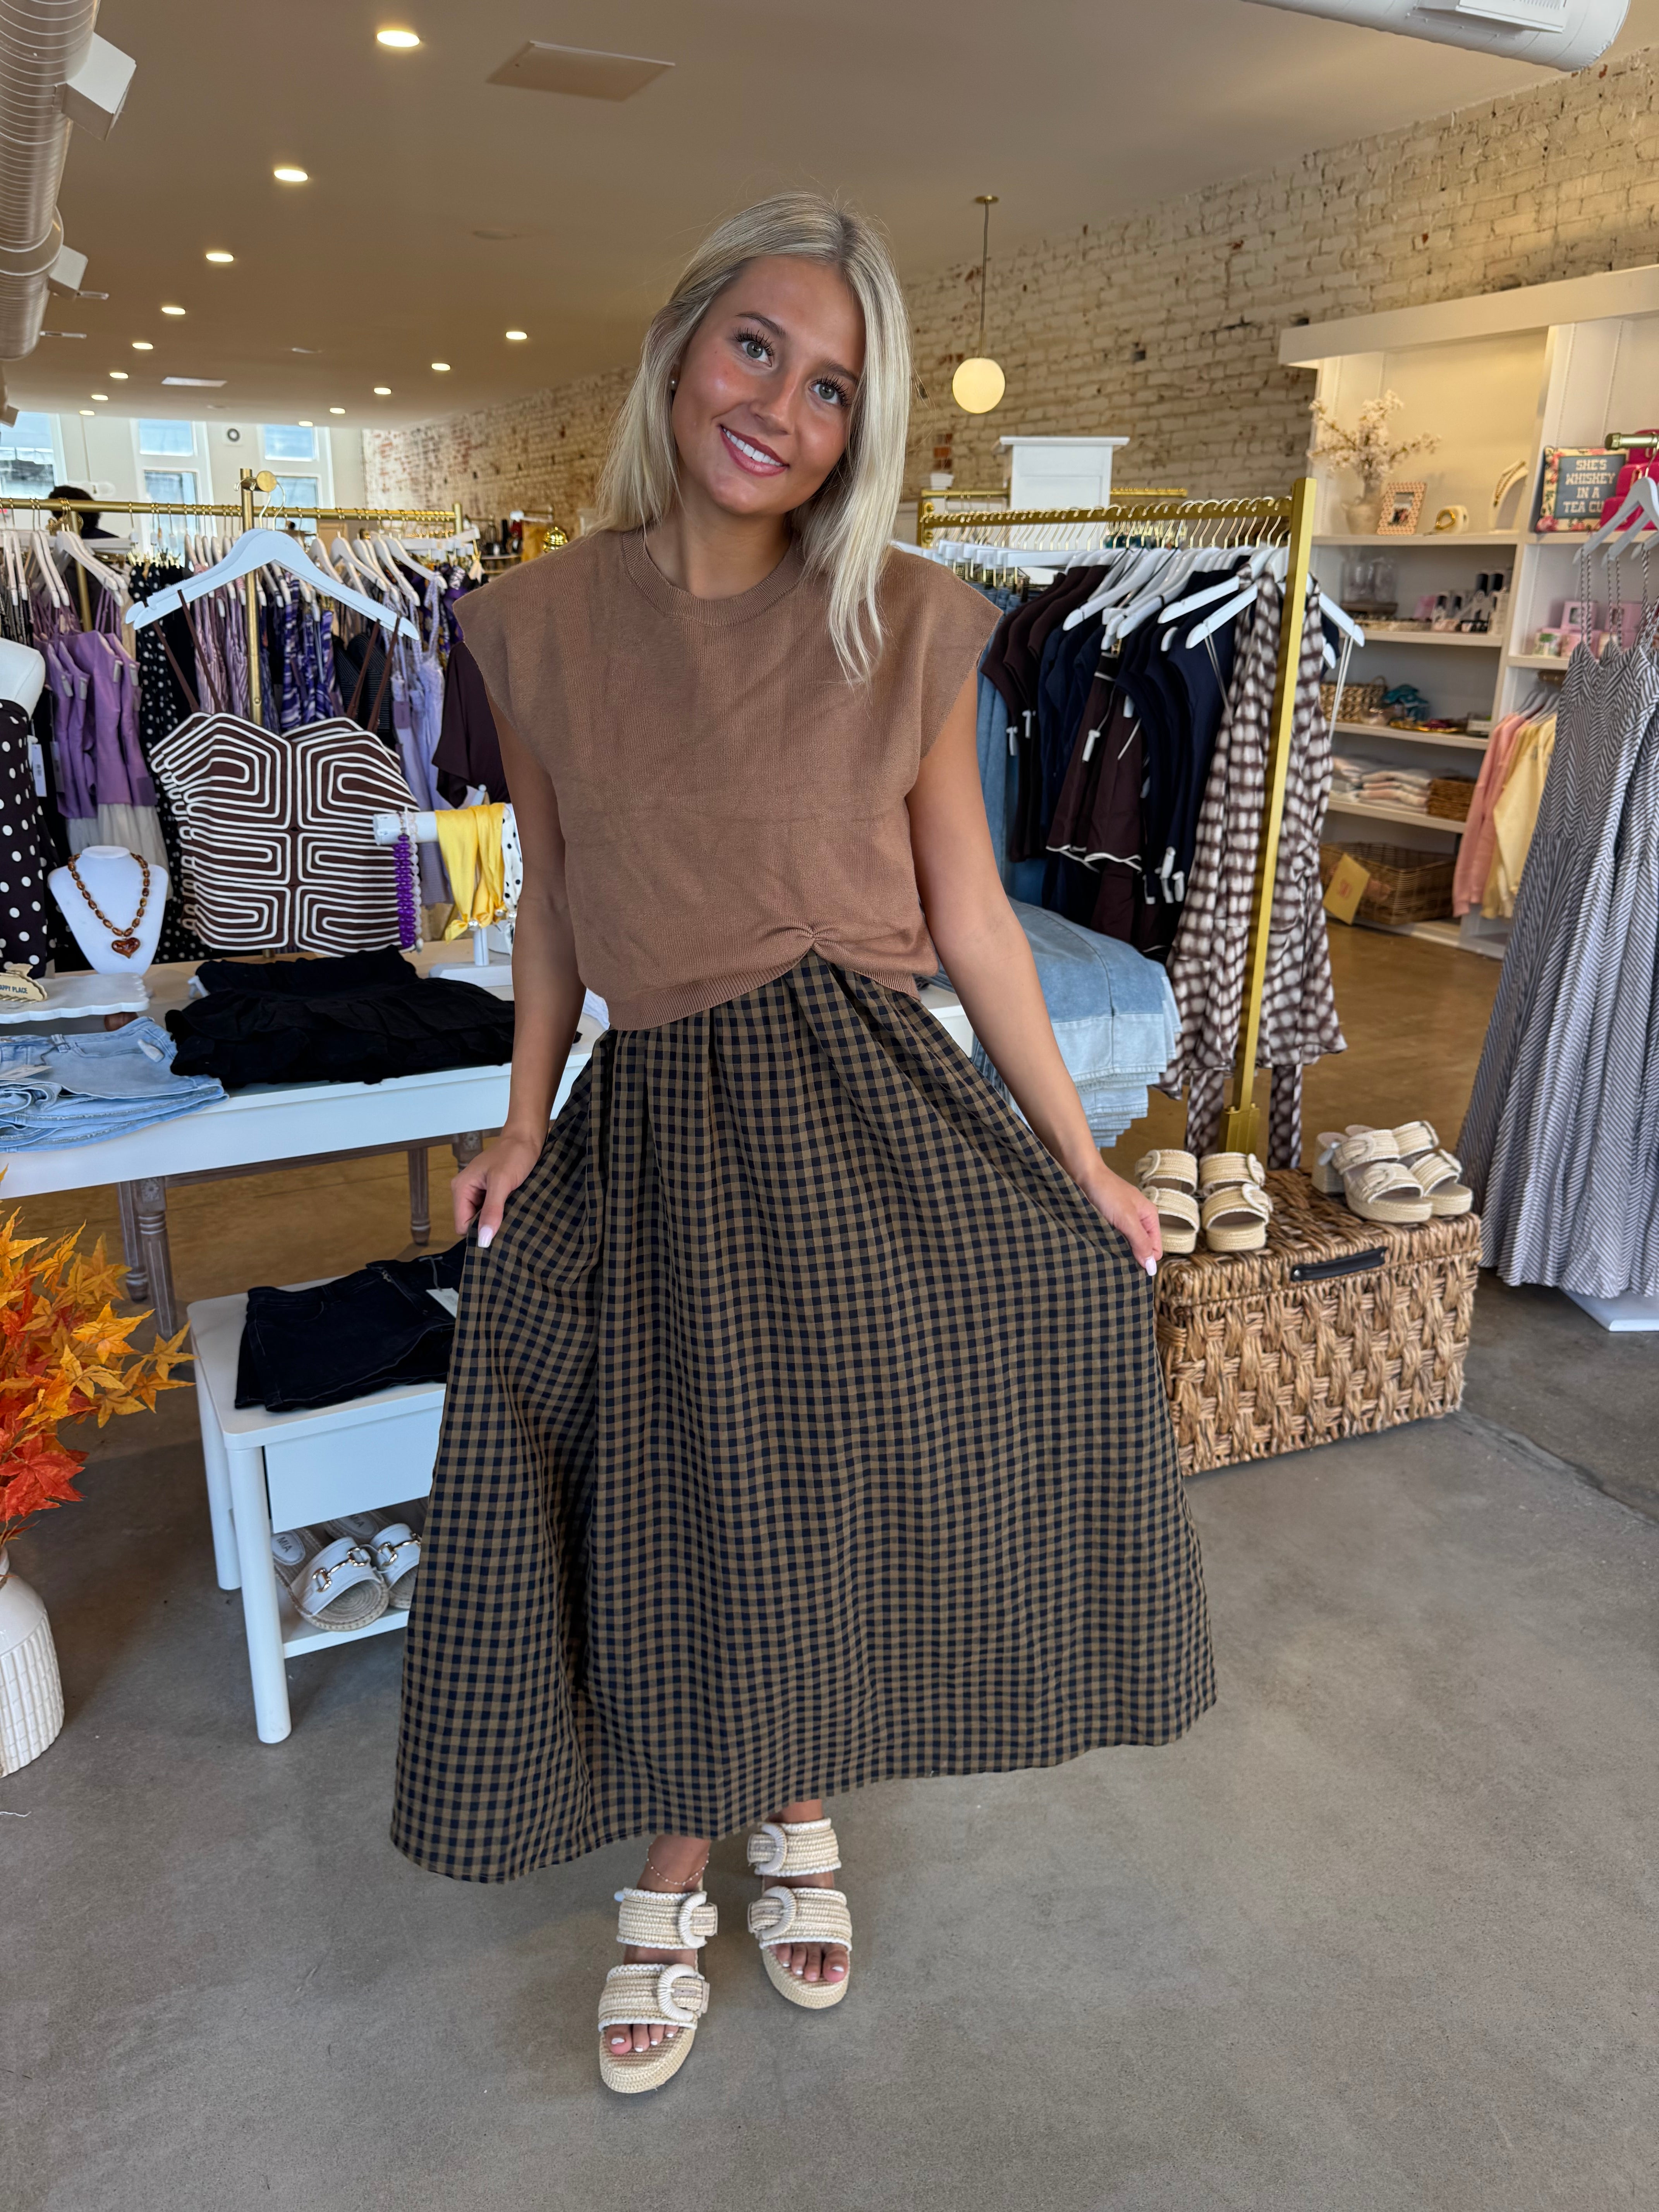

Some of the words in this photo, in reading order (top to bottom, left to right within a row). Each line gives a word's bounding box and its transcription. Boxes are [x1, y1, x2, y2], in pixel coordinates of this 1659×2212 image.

[1565, 472, 1615, 485] WHISKEY
[1577, 486, 1589, 499] IN
[1591, 486, 1600, 498] A
[1563, 501, 1585, 513] TEA
[1589, 500, 1605, 513] CU
[276, 1536, 292, 1553] MIA
